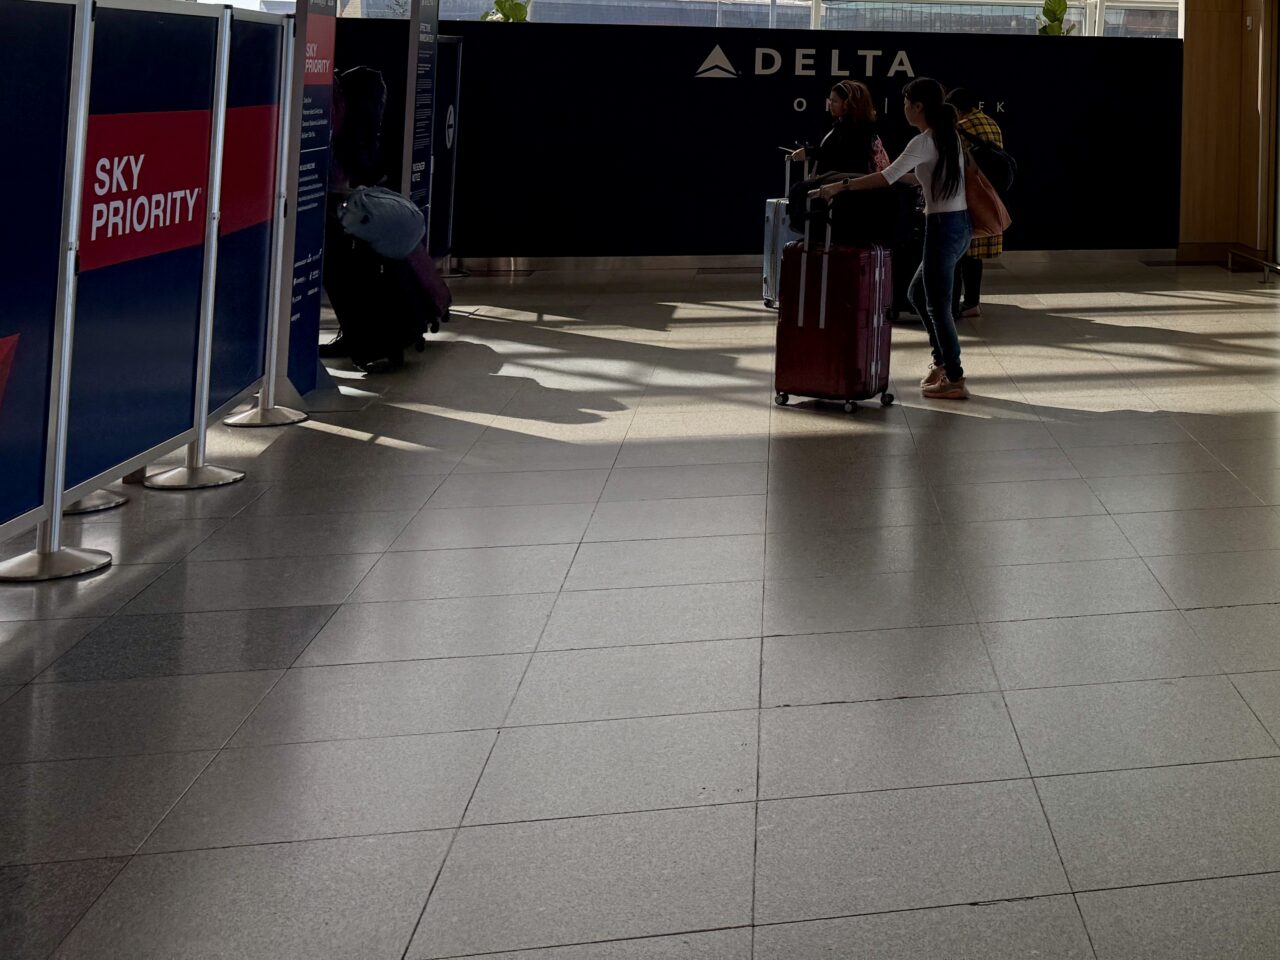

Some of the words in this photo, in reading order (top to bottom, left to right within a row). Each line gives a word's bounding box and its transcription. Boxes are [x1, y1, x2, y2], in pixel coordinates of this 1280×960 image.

[305, 42, 318, 57] SKY
[754, 47, 916, 78] DELTA
[304, 58, 331, 73] PRIORITY
[94, 153, 146, 196] SKY
[90, 187, 200, 242] PRIORITY
